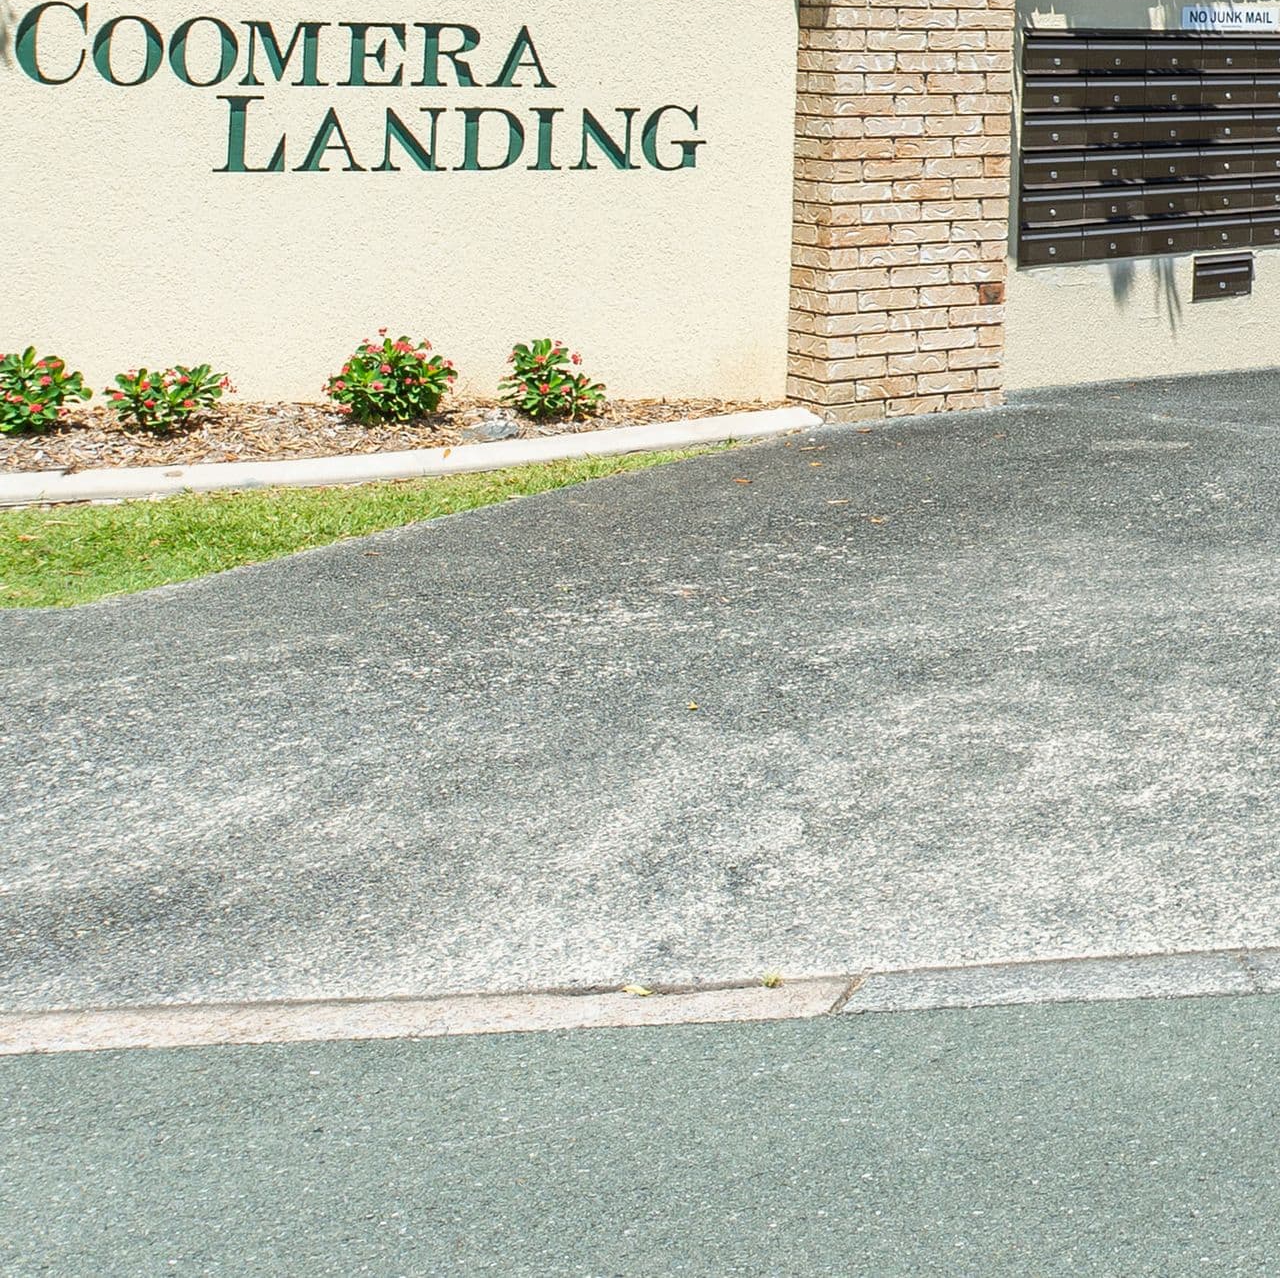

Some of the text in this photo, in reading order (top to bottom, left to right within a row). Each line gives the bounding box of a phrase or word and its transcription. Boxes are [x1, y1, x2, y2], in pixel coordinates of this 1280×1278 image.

[15, 1, 556, 88] COOMERA
[1189, 10, 1273, 24] NO JUNK MAIL
[212, 95, 706, 172] LANDING
